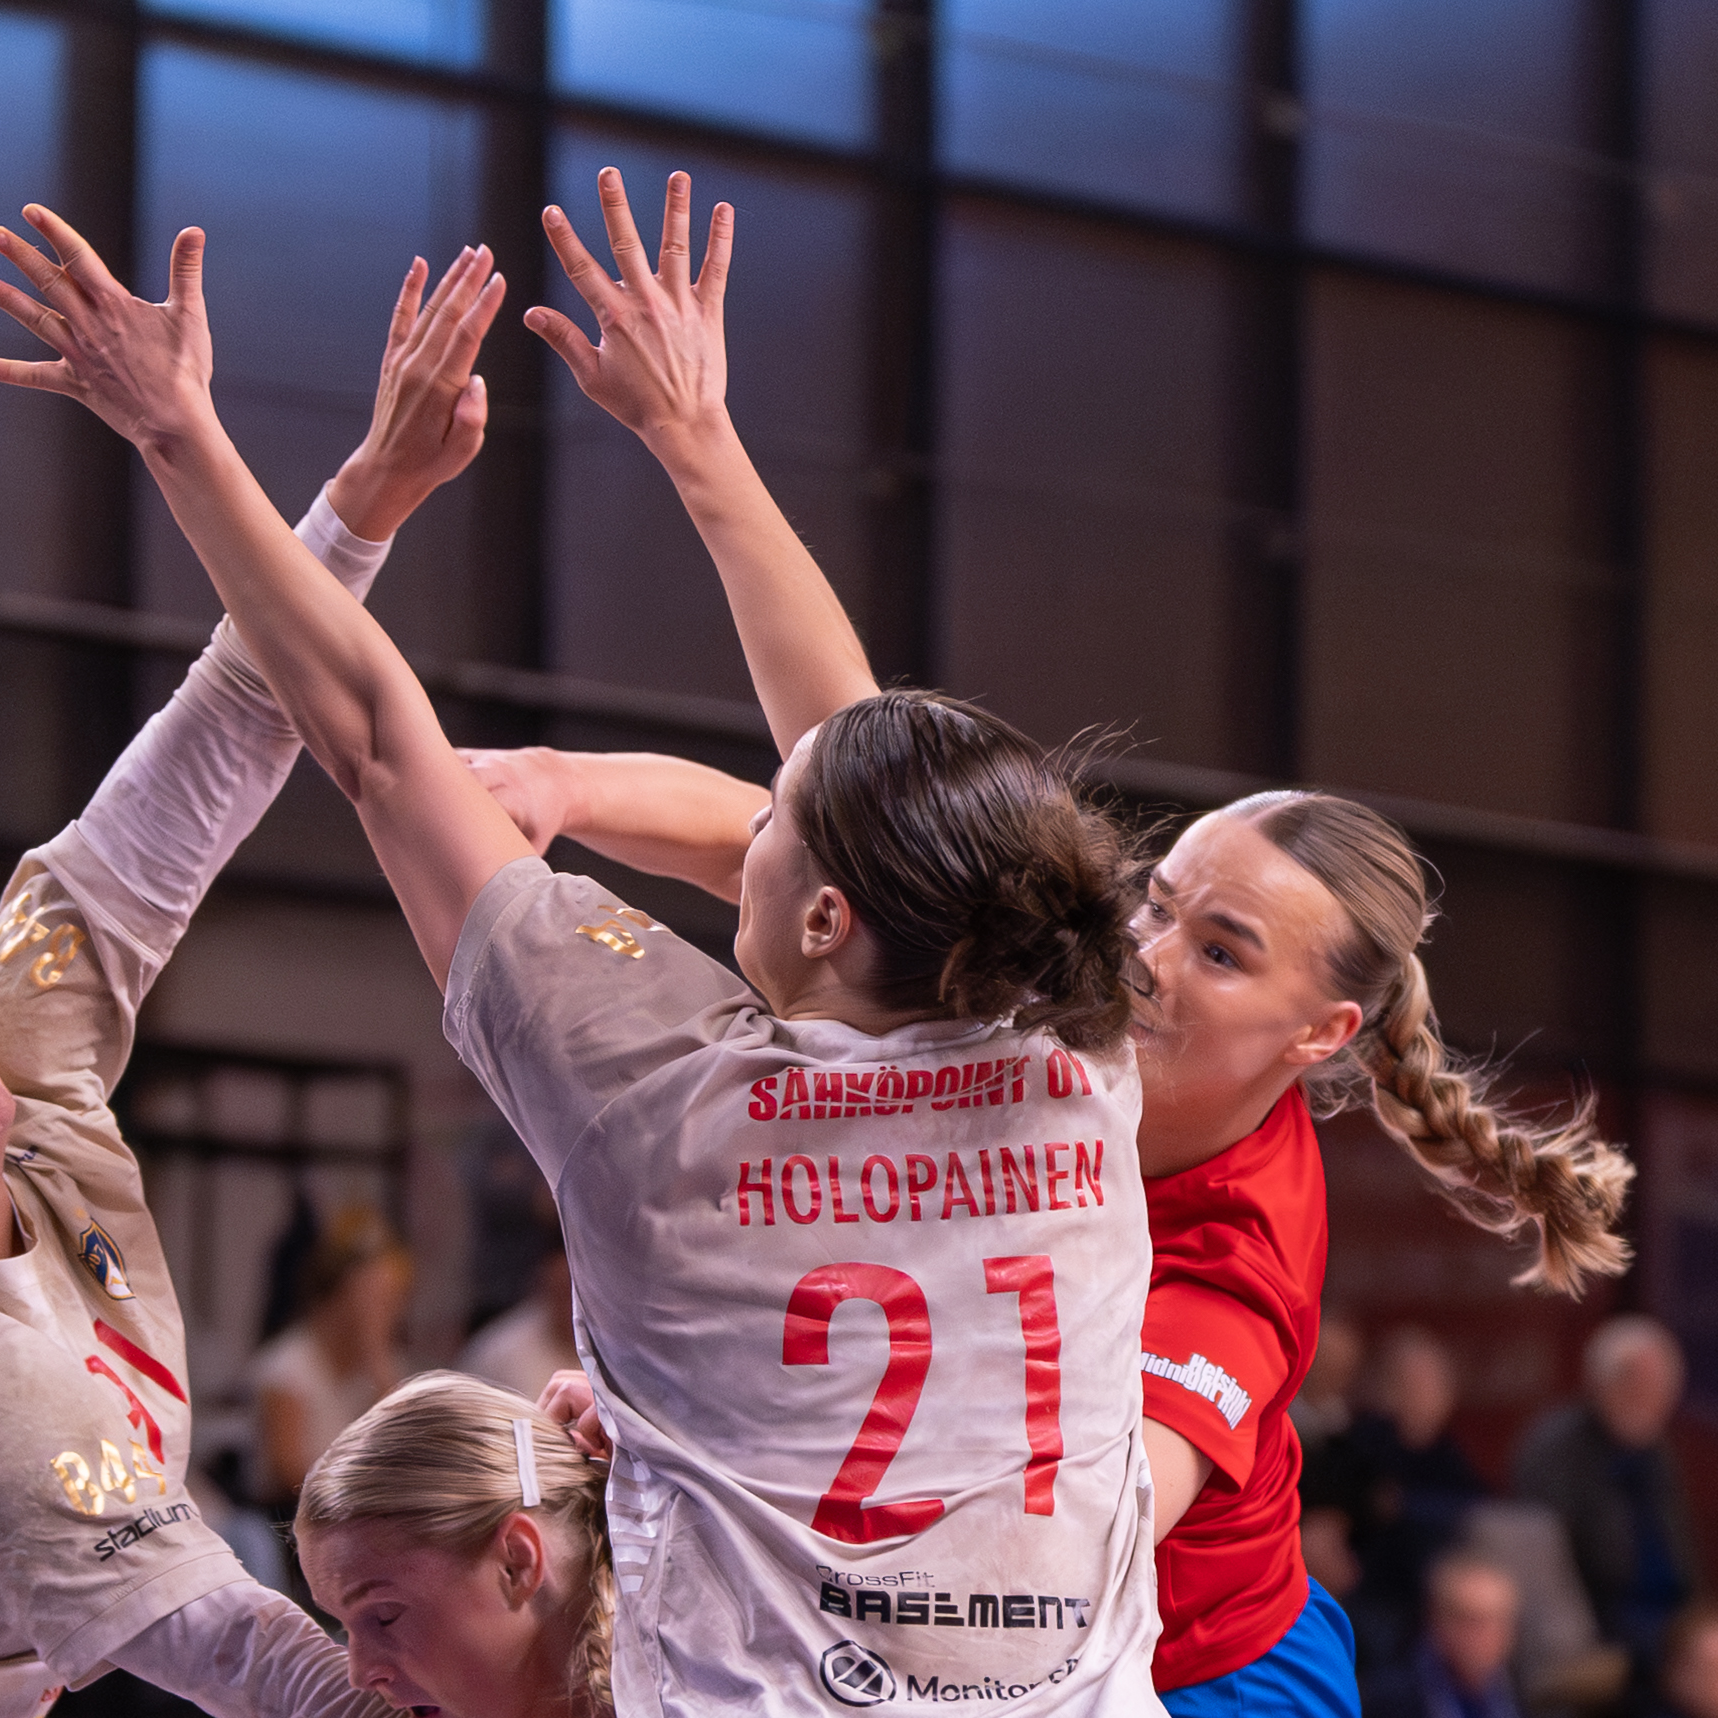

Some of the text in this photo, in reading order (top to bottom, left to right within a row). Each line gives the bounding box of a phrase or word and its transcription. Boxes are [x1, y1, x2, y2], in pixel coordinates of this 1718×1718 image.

[748, 1055, 1031, 1121] SÄHKÖPOINT
[737, 1138, 1104, 1226] HOLOPAINEN
[782, 1255, 1064, 1544] 21
[93, 1503, 200, 1562] stadium
[819, 1581, 1091, 1629] BASEMENT
